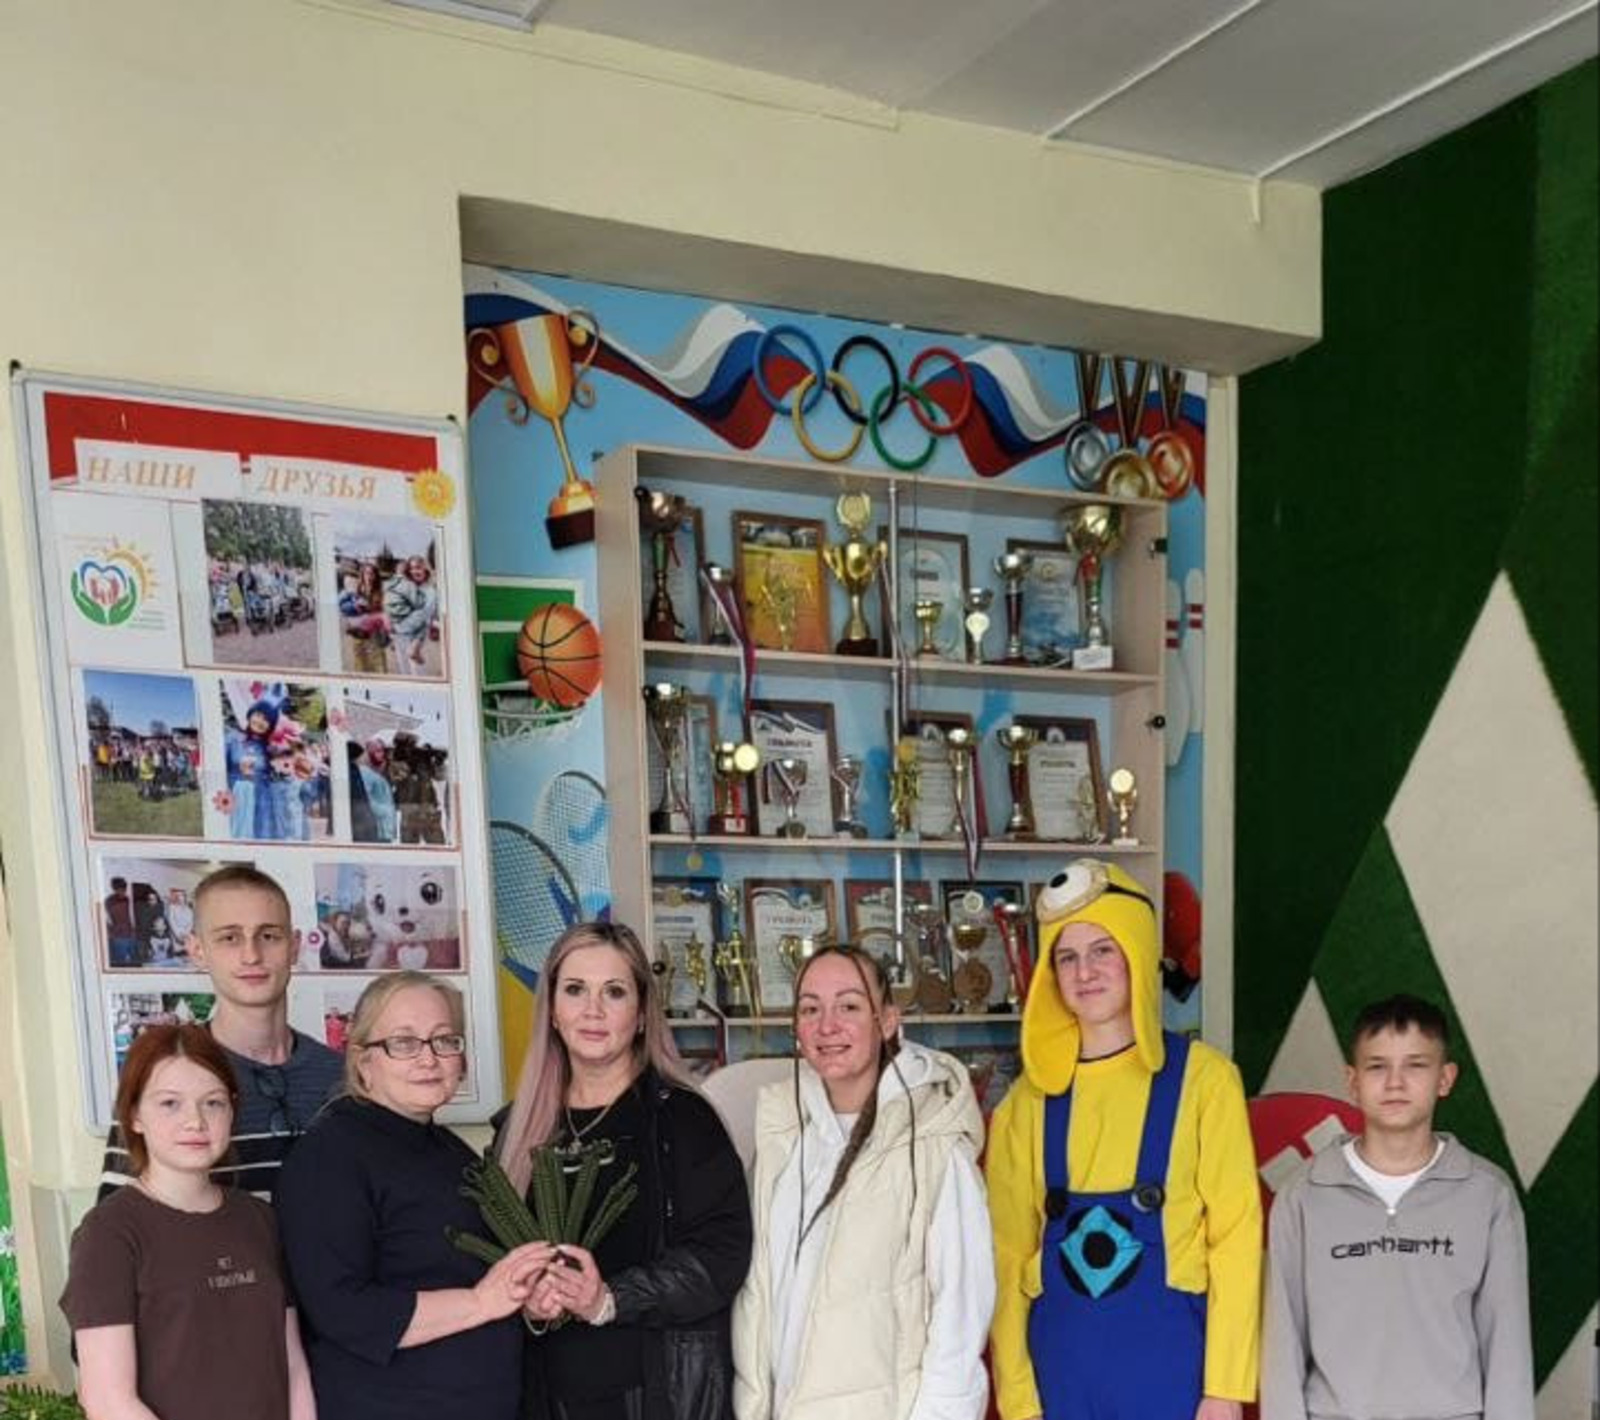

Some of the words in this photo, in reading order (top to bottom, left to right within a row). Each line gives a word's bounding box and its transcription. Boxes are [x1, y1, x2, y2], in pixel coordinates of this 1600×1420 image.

[87, 456, 196, 489] НАШИ
[257, 465, 377, 500] ДРУЗЬЯ
[1331, 1236, 1453, 1259] carhartt
